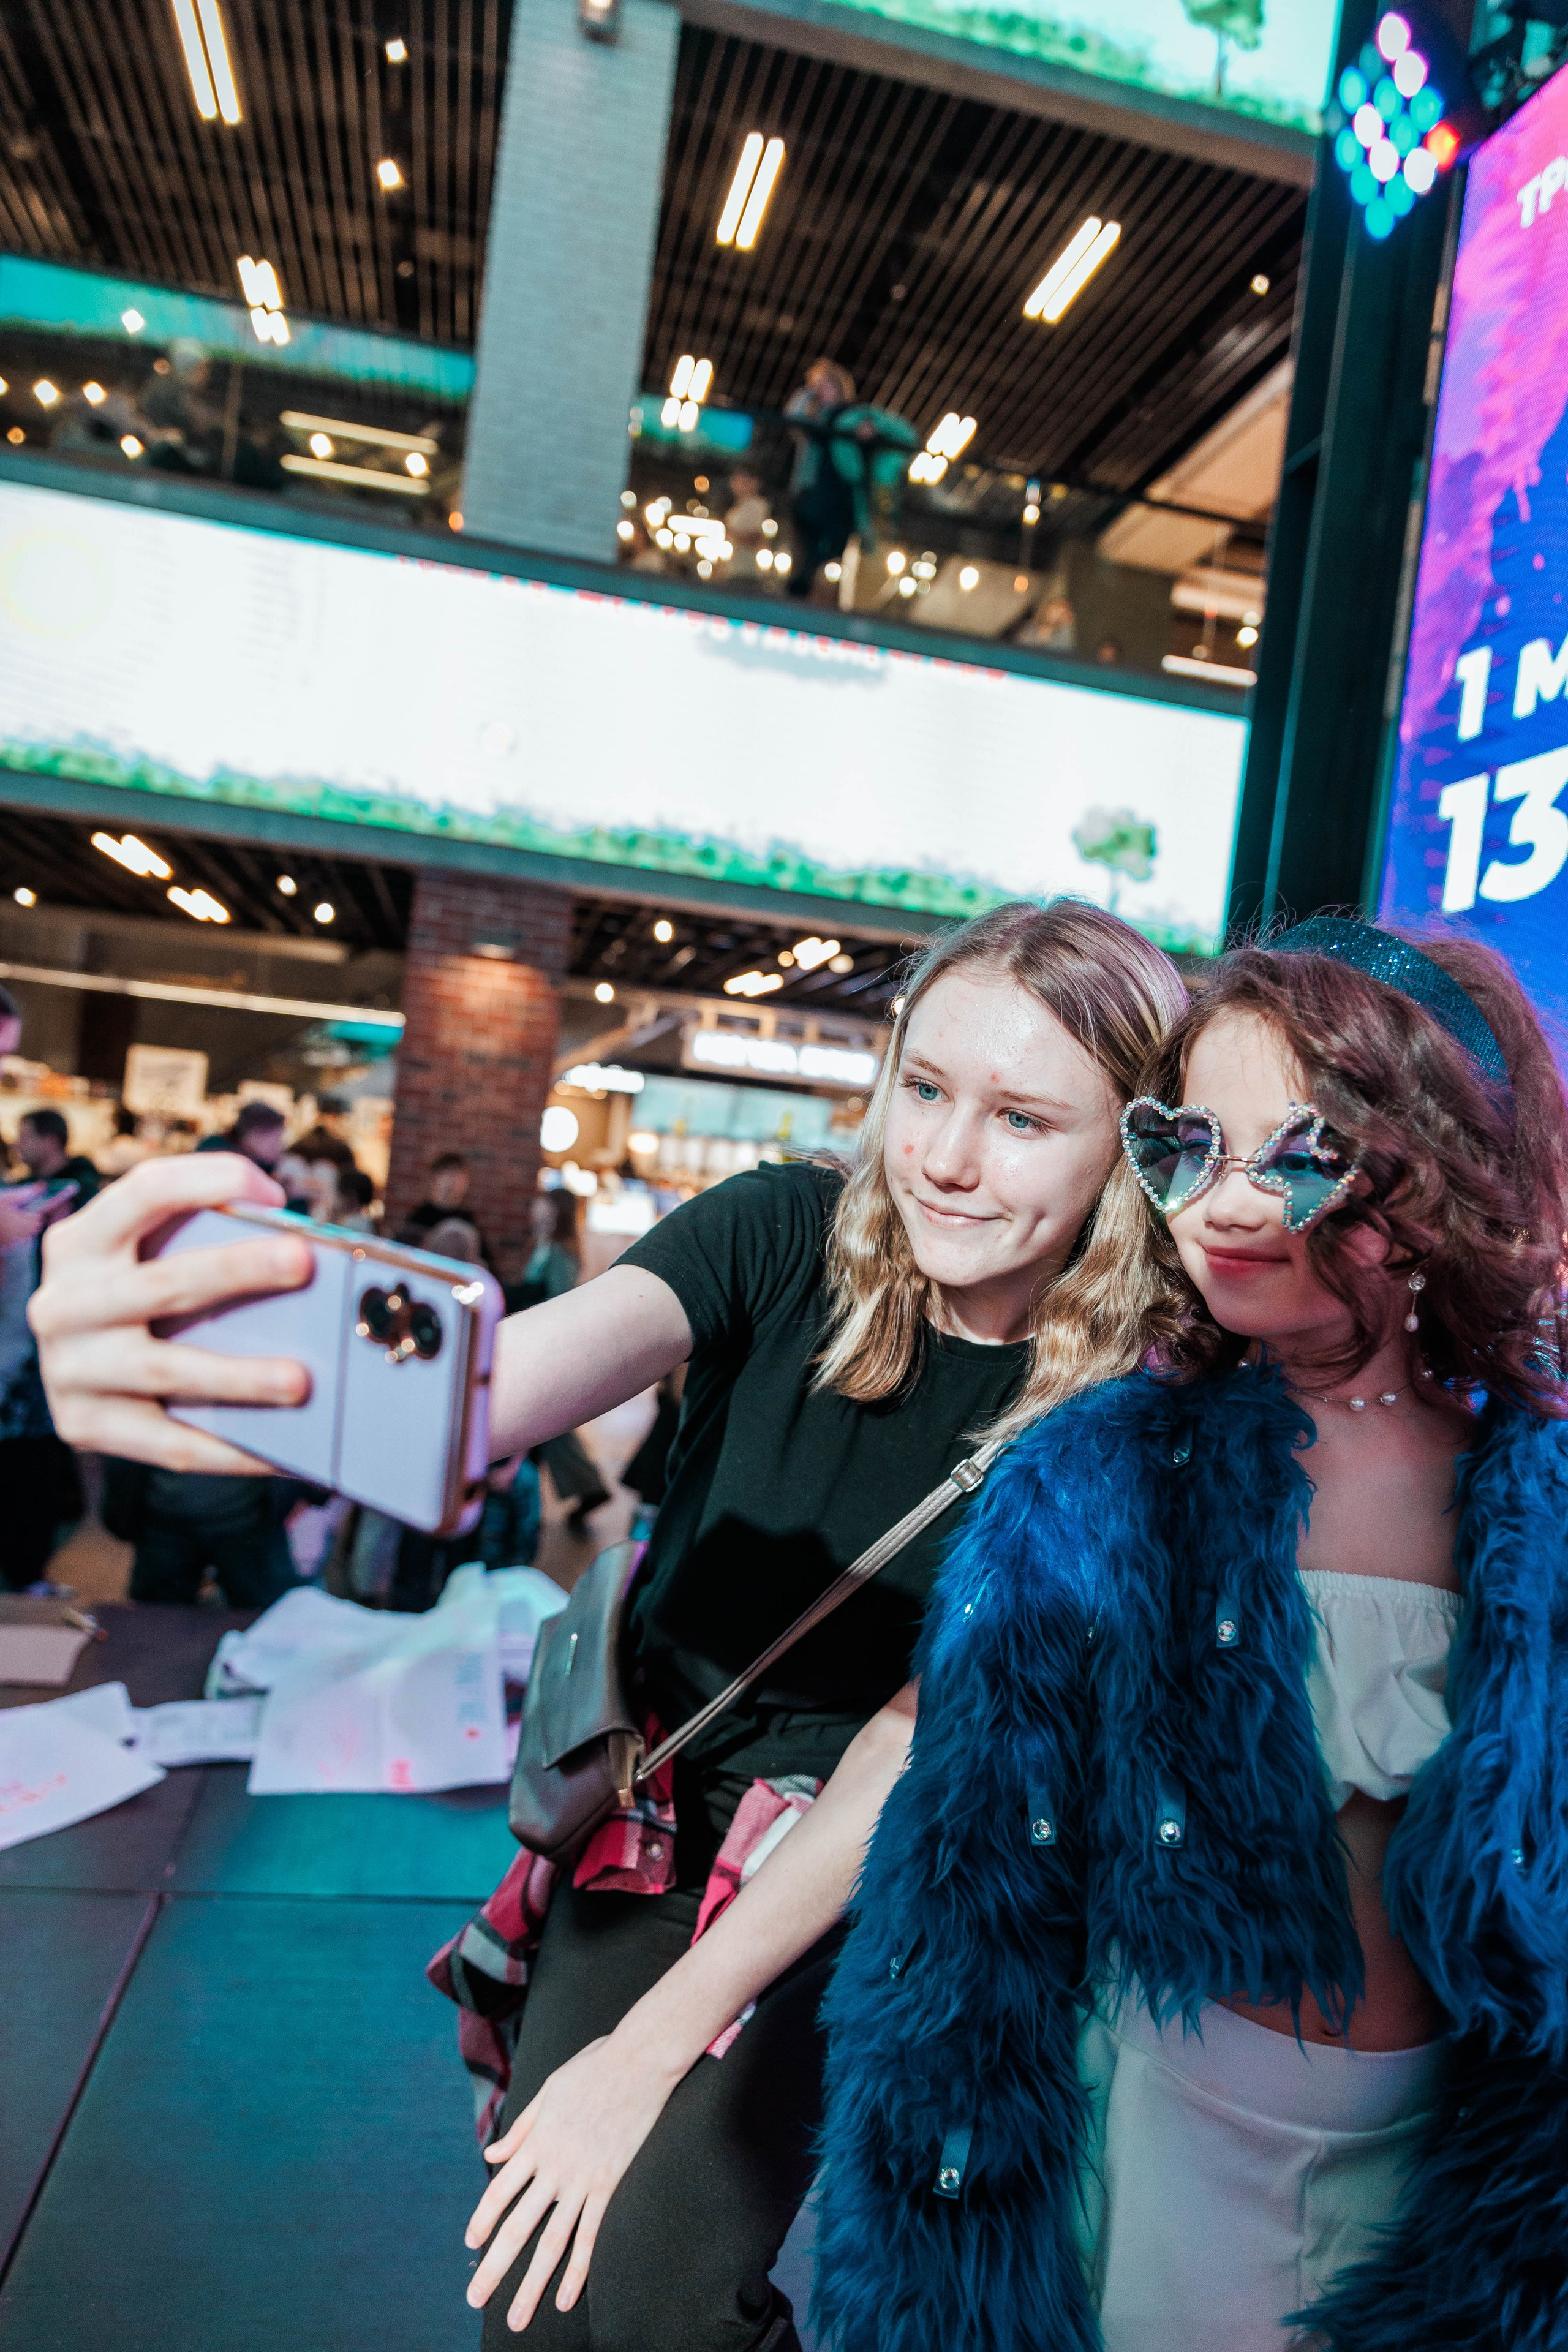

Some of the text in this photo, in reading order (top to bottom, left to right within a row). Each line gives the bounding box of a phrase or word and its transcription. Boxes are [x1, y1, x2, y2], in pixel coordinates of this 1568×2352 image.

[1516, 154, 1568, 228] ТР
[1455, 645, 1492, 742] 1
[1438, 744, 1568, 913] 13
